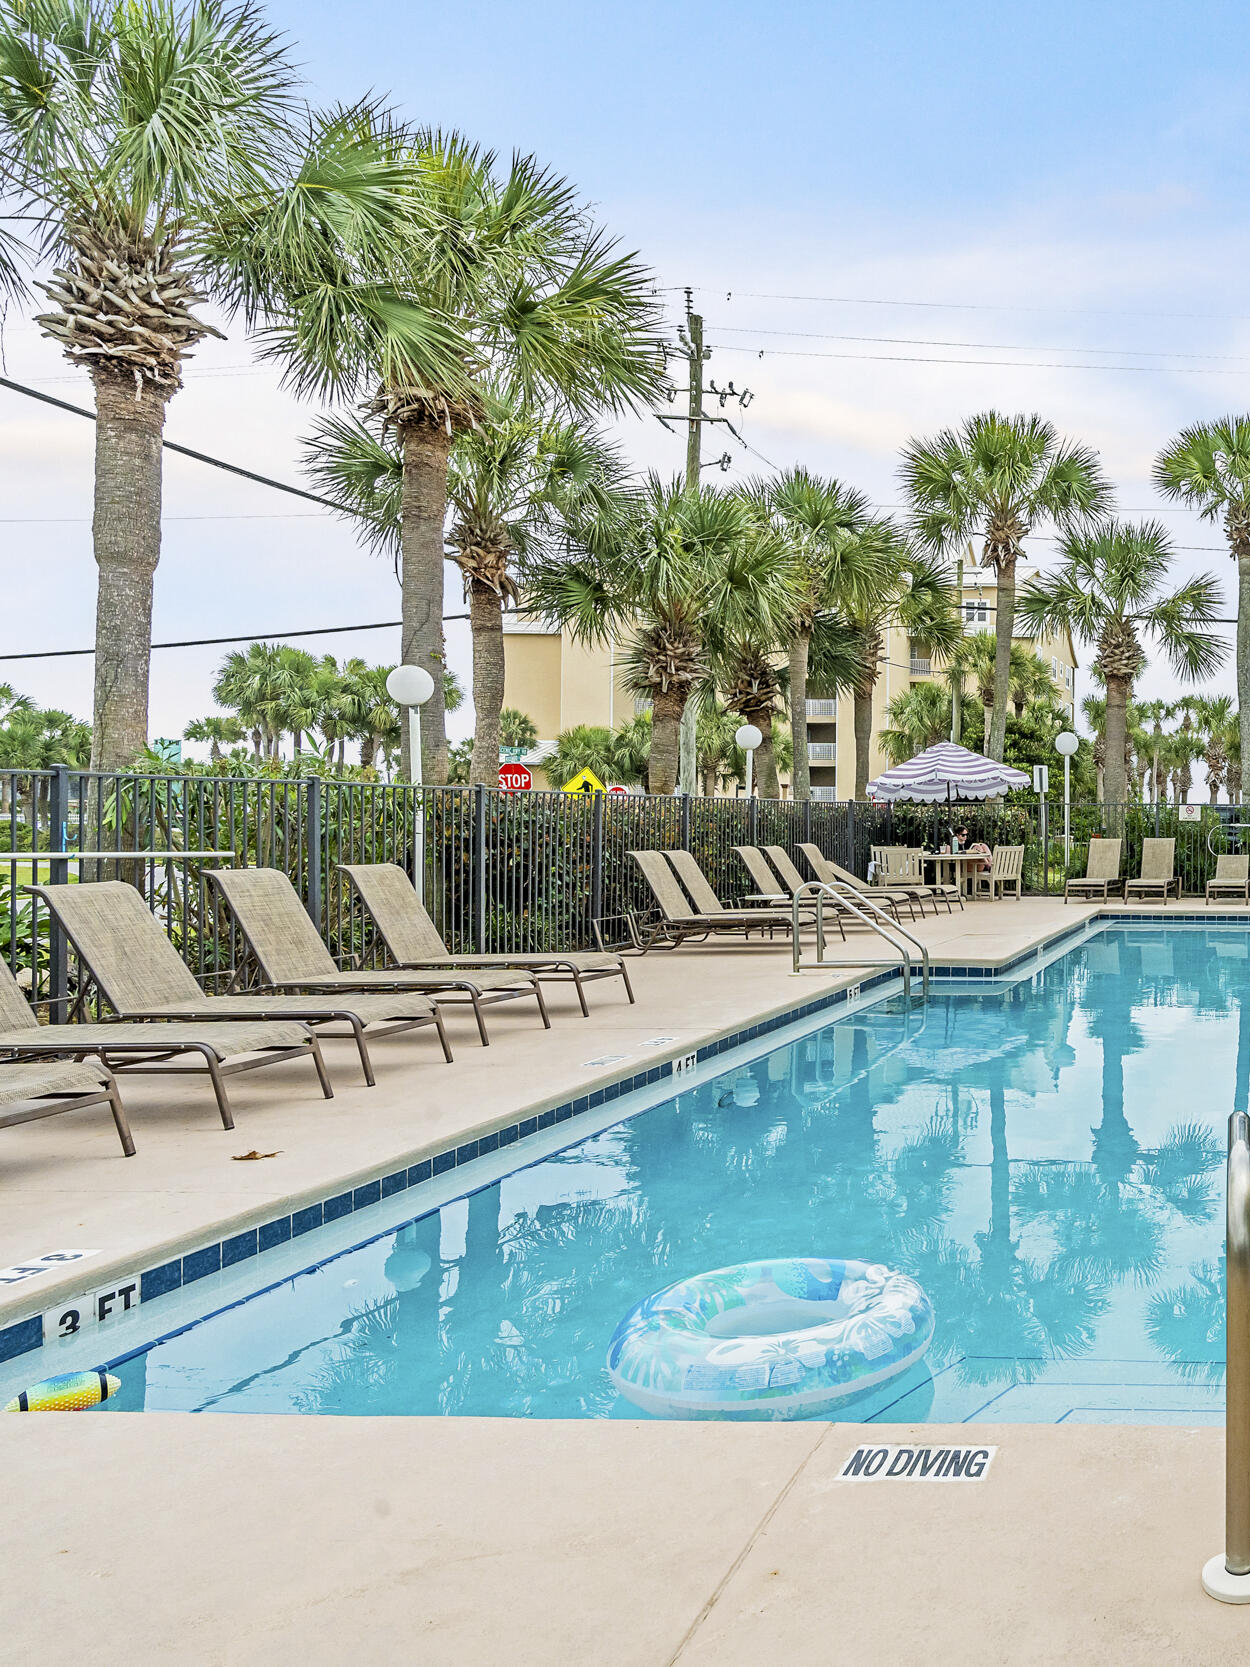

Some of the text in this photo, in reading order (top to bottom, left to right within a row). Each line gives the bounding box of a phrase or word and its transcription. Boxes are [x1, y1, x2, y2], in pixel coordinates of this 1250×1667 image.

[498, 774, 529, 788] STOP
[686, 1055, 696, 1069] FT
[58, 1310, 80, 1338] 3
[842, 1449, 989, 1478] NO DIVING
